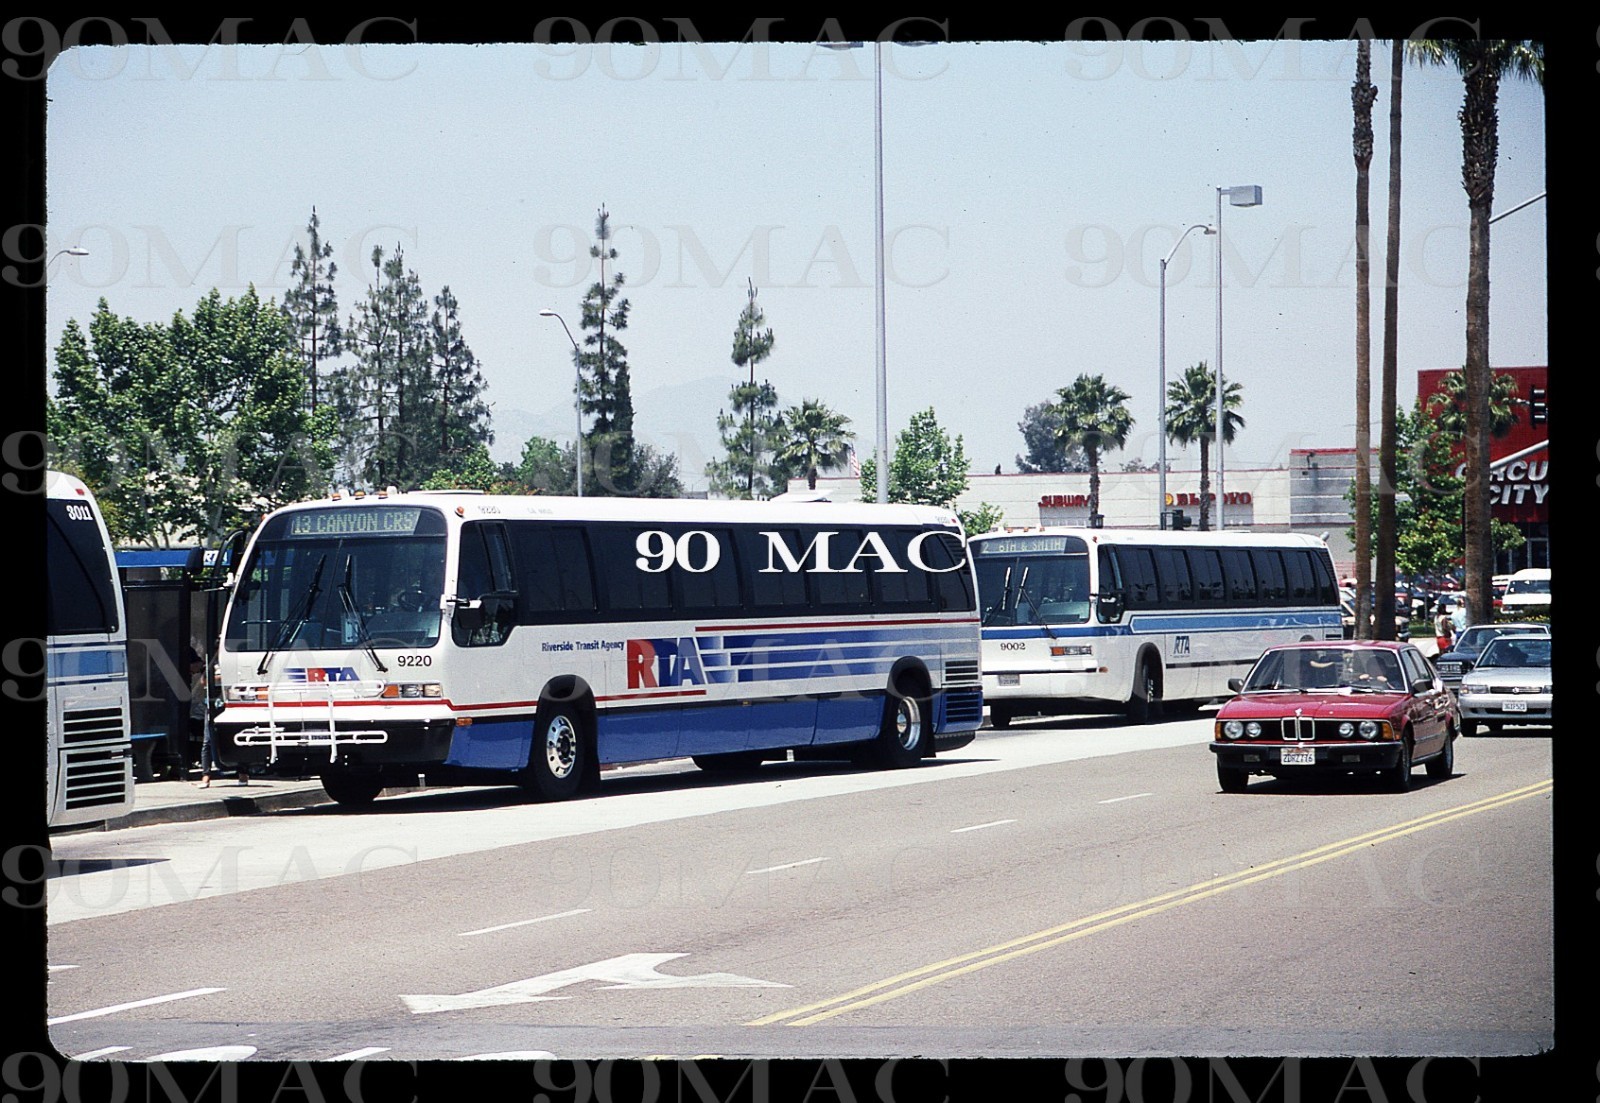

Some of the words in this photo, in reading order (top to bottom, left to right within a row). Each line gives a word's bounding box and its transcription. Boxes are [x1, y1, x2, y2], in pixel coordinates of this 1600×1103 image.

[1455, 461, 1548, 481] CRCU
[66, 505, 93, 520] 3011
[294, 516, 311, 533] 13
[317, 513, 378, 532] CANYON
[981, 541, 990, 554] 2
[1032, 538, 1061, 551] SMITH
[542, 643, 573, 652] Riverside
[576, 641, 600, 650] Transit
[601, 640, 625, 650] Agency
[1000, 642, 1026, 651] 9002
[1173, 635, 1190, 654] RTA
[397, 655, 432, 667] 9220
[627, 636, 706, 689] RTA
[306, 667, 360, 682] RTA
